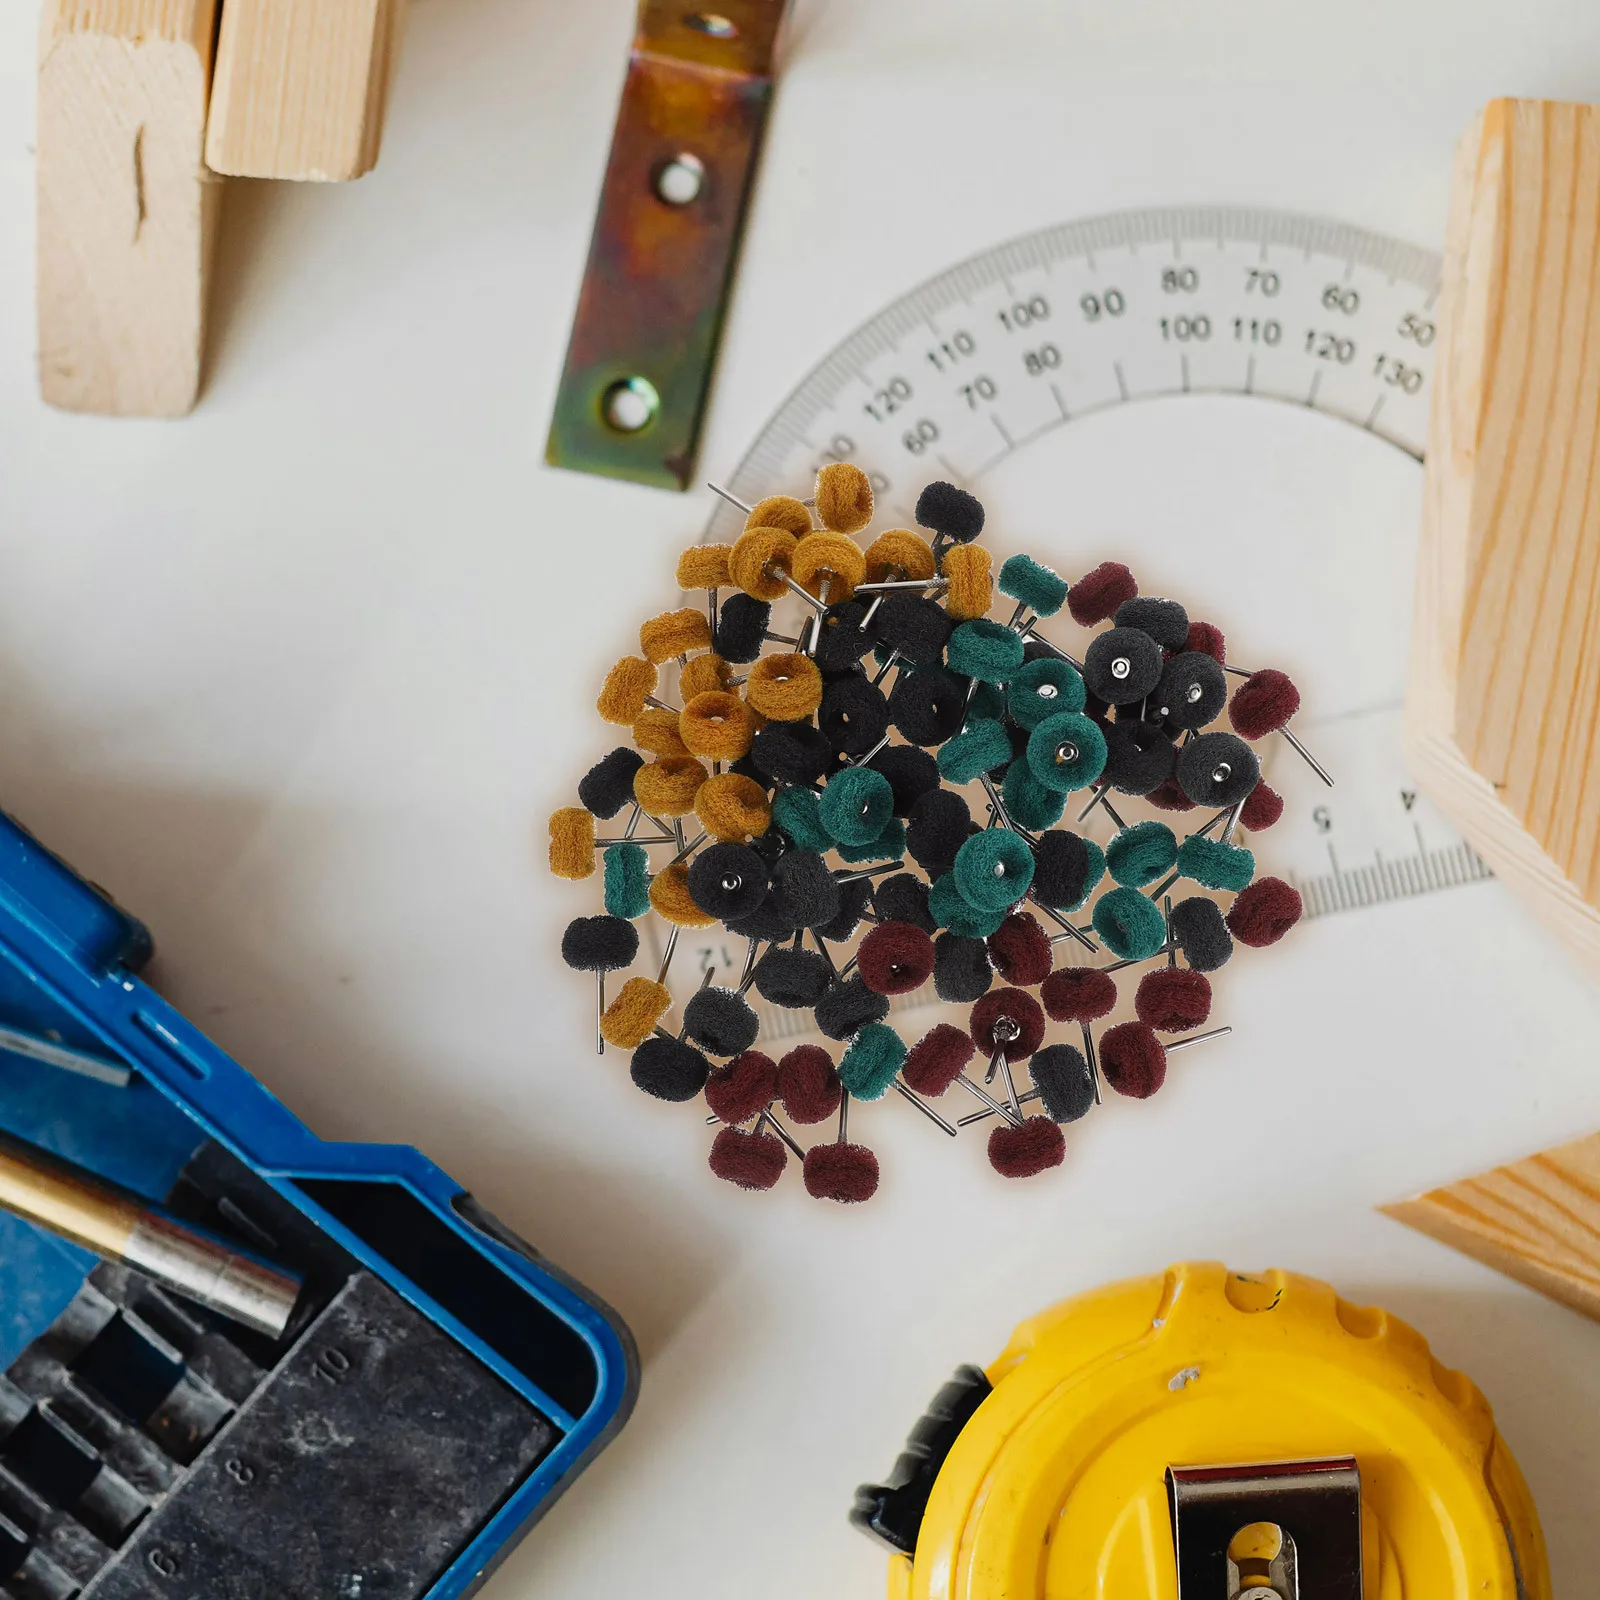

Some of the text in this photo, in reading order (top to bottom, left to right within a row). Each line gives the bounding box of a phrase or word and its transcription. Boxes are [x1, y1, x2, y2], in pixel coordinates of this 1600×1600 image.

[1161, 266, 1199, 294] 80
[1245, 268, 1281, 297] 70
[998, 295, 1049, 332] 100
[1080, 287, 1125, 322] 90
[1322, 284, 1360, 315] 60
[1160, 315, 1211, 342] 100
[1233, 316, 1281, 346] 110
[1397, 313, 1436, 347] 50
[926, 331, 976, 372] 110
[1024, 342, 1062, 376] 80
[1305, 329, 1355, 365] 120
[1374, 353, 1424, 394] 130
[864, 377, 913, 422] 120
[903, 418, 940, 455] 60
[311, 1348, 350, 1385] 10
[225, 1458, 254, 1486] 8
[149, 1549, 178, 1577] 6
